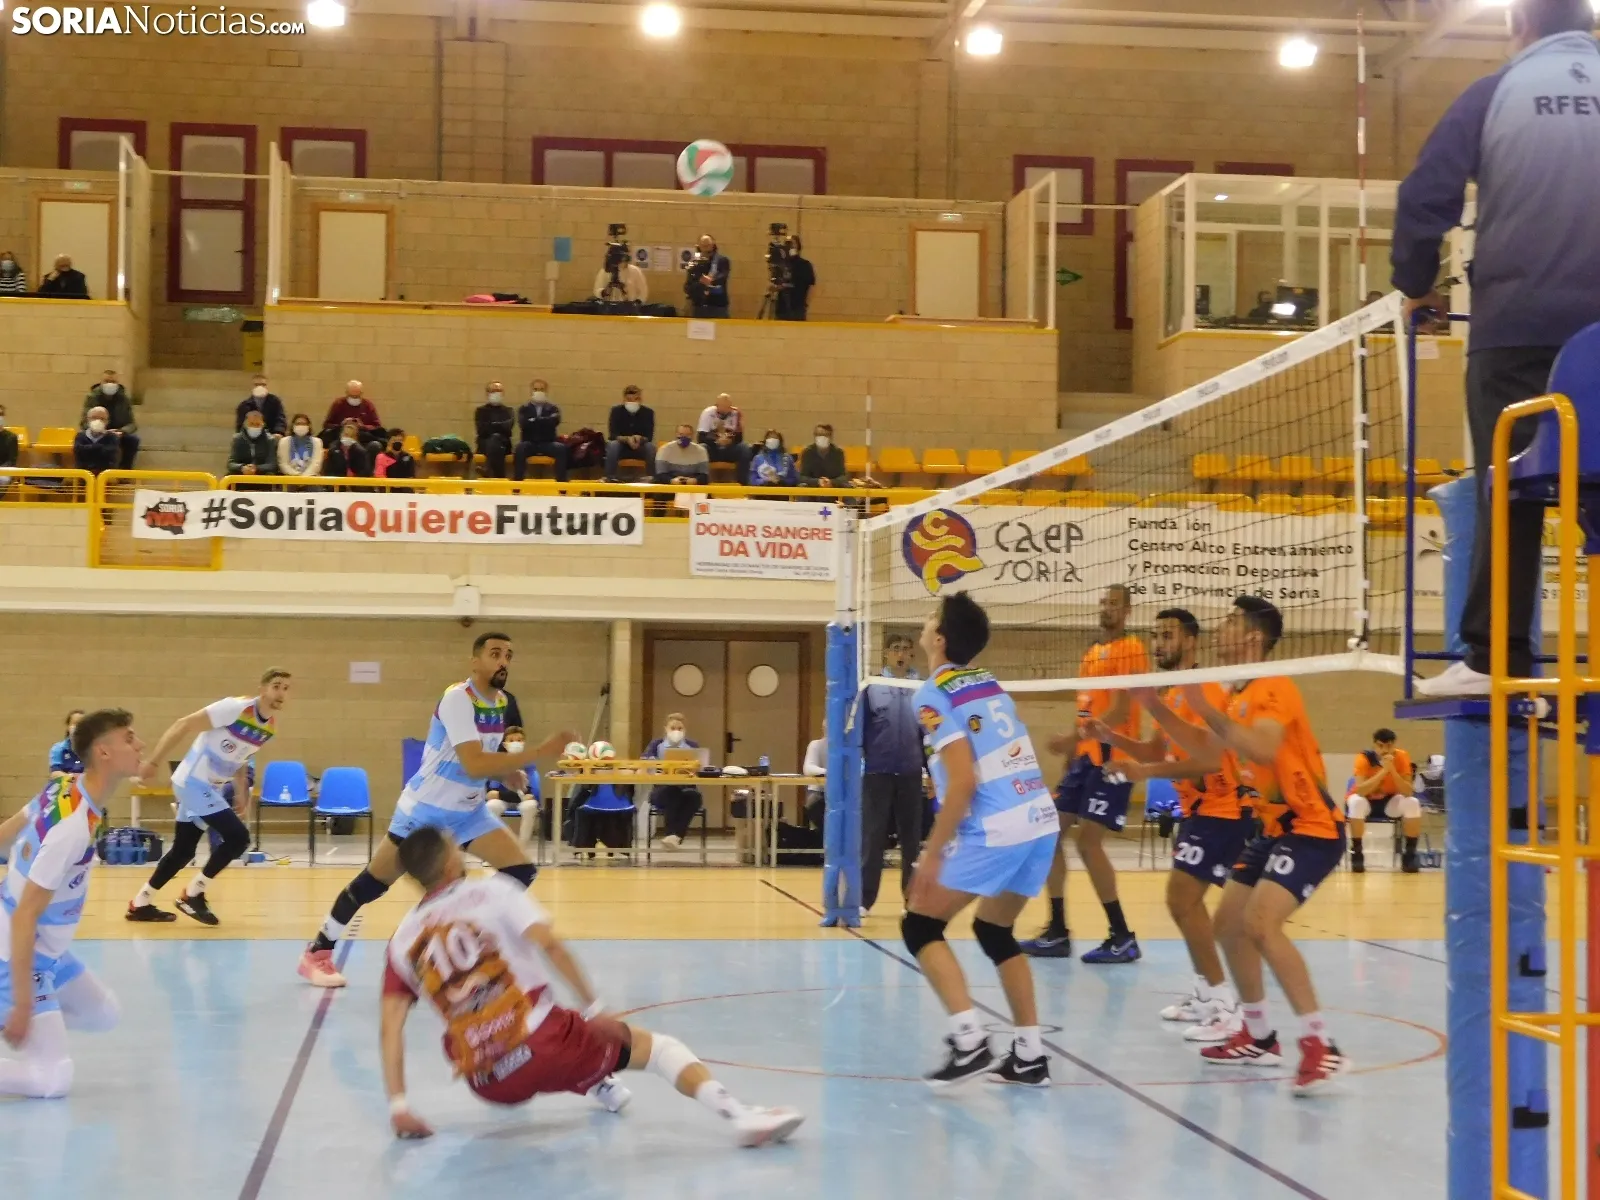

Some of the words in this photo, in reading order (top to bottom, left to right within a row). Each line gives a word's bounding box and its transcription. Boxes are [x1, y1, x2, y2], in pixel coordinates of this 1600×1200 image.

[202, 497, 636, 538] #SoriaQuiereFuturo
[695, 522, 757, 538] DONAR
[761, 525, 833, 541] SANGRE
[719, 540, 749, 557] DA
[756, 541, 809, 560] VIDA
[1128, 538, 1184, 552] Centro
[1190, 541, 1225, 555] Alto
[1127, 563, 1138, 577] y
[1236, 564, 1319, 582] Deportiva
[1128, 582, 1147, 595] de
[1153, 583, 1166, 595] la
[1253, 587, 1274, 600] de
[1279, 587, 1320, 600] Soria
[986, 699, 1015, 739] 5
[1087, 798, 1109, 816] 12
[1175, 842, 1204, 866] 20
[1264, 853, 1295, 875] 10
[424, 921, 480, 982] 10
